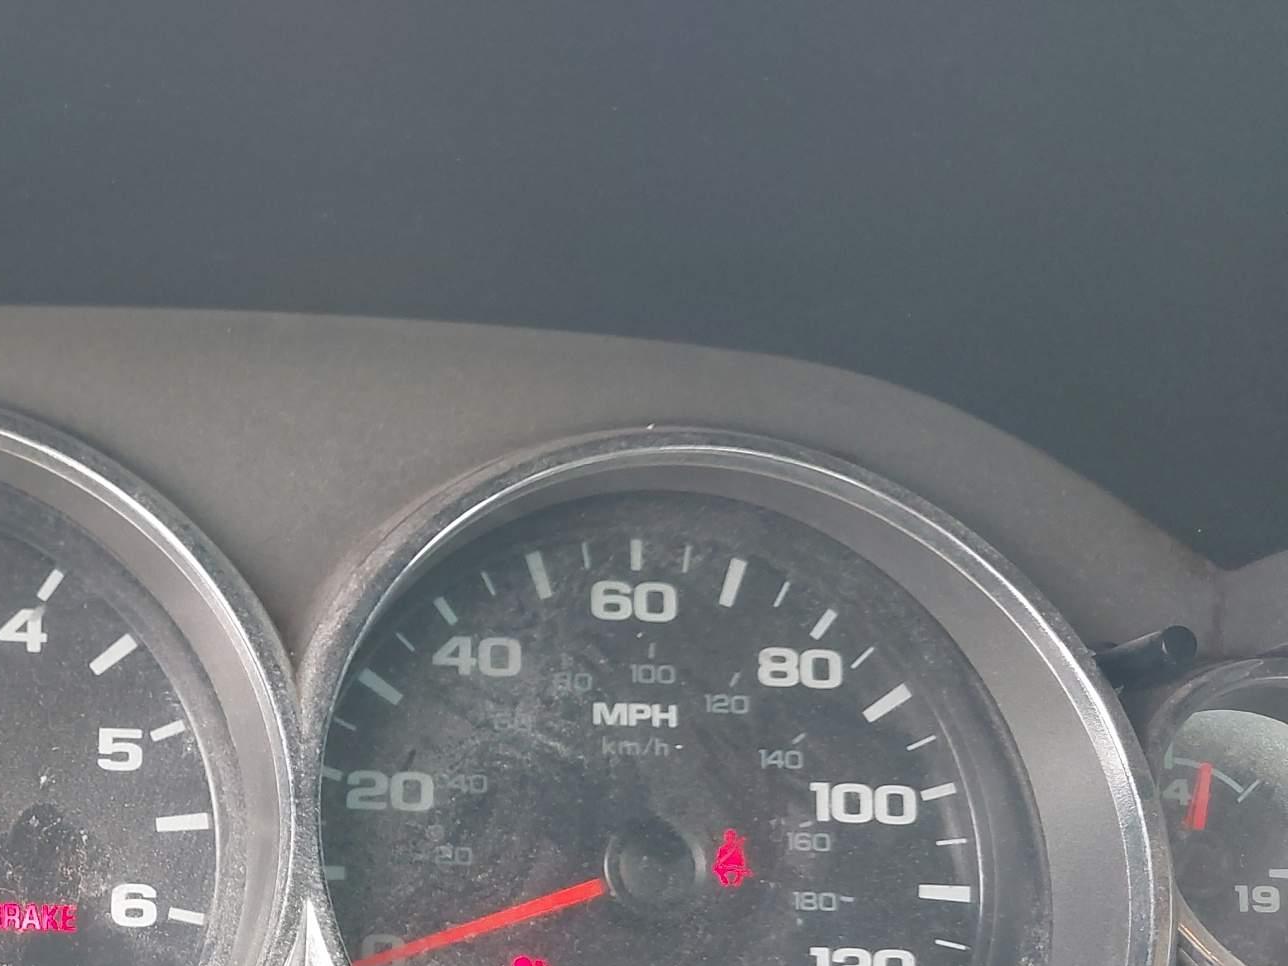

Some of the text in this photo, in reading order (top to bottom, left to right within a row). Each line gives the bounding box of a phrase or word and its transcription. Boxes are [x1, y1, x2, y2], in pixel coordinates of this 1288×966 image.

[590, 580, 678, 622] 60
[432, 637, 522, 677] 40
[757, 647, 843, 690] 80
[631, 664, 675, 685] 100
[593, 702, 678, 727] MPH
[705, 693, 749, 715] 120
[98, 727, 143, 772] 5
[601, 735, 669, 757] km/h
[759, 749, 804, 769] 140
[345, 769, 435, 812] 20
[810, 781, 917, 825] 100
[786, 832, 831, 853] 160
[110, 884, 157, 928] 6
[794, 890, 837, 911] 180
[1234, 884, 1280, 914] 19
